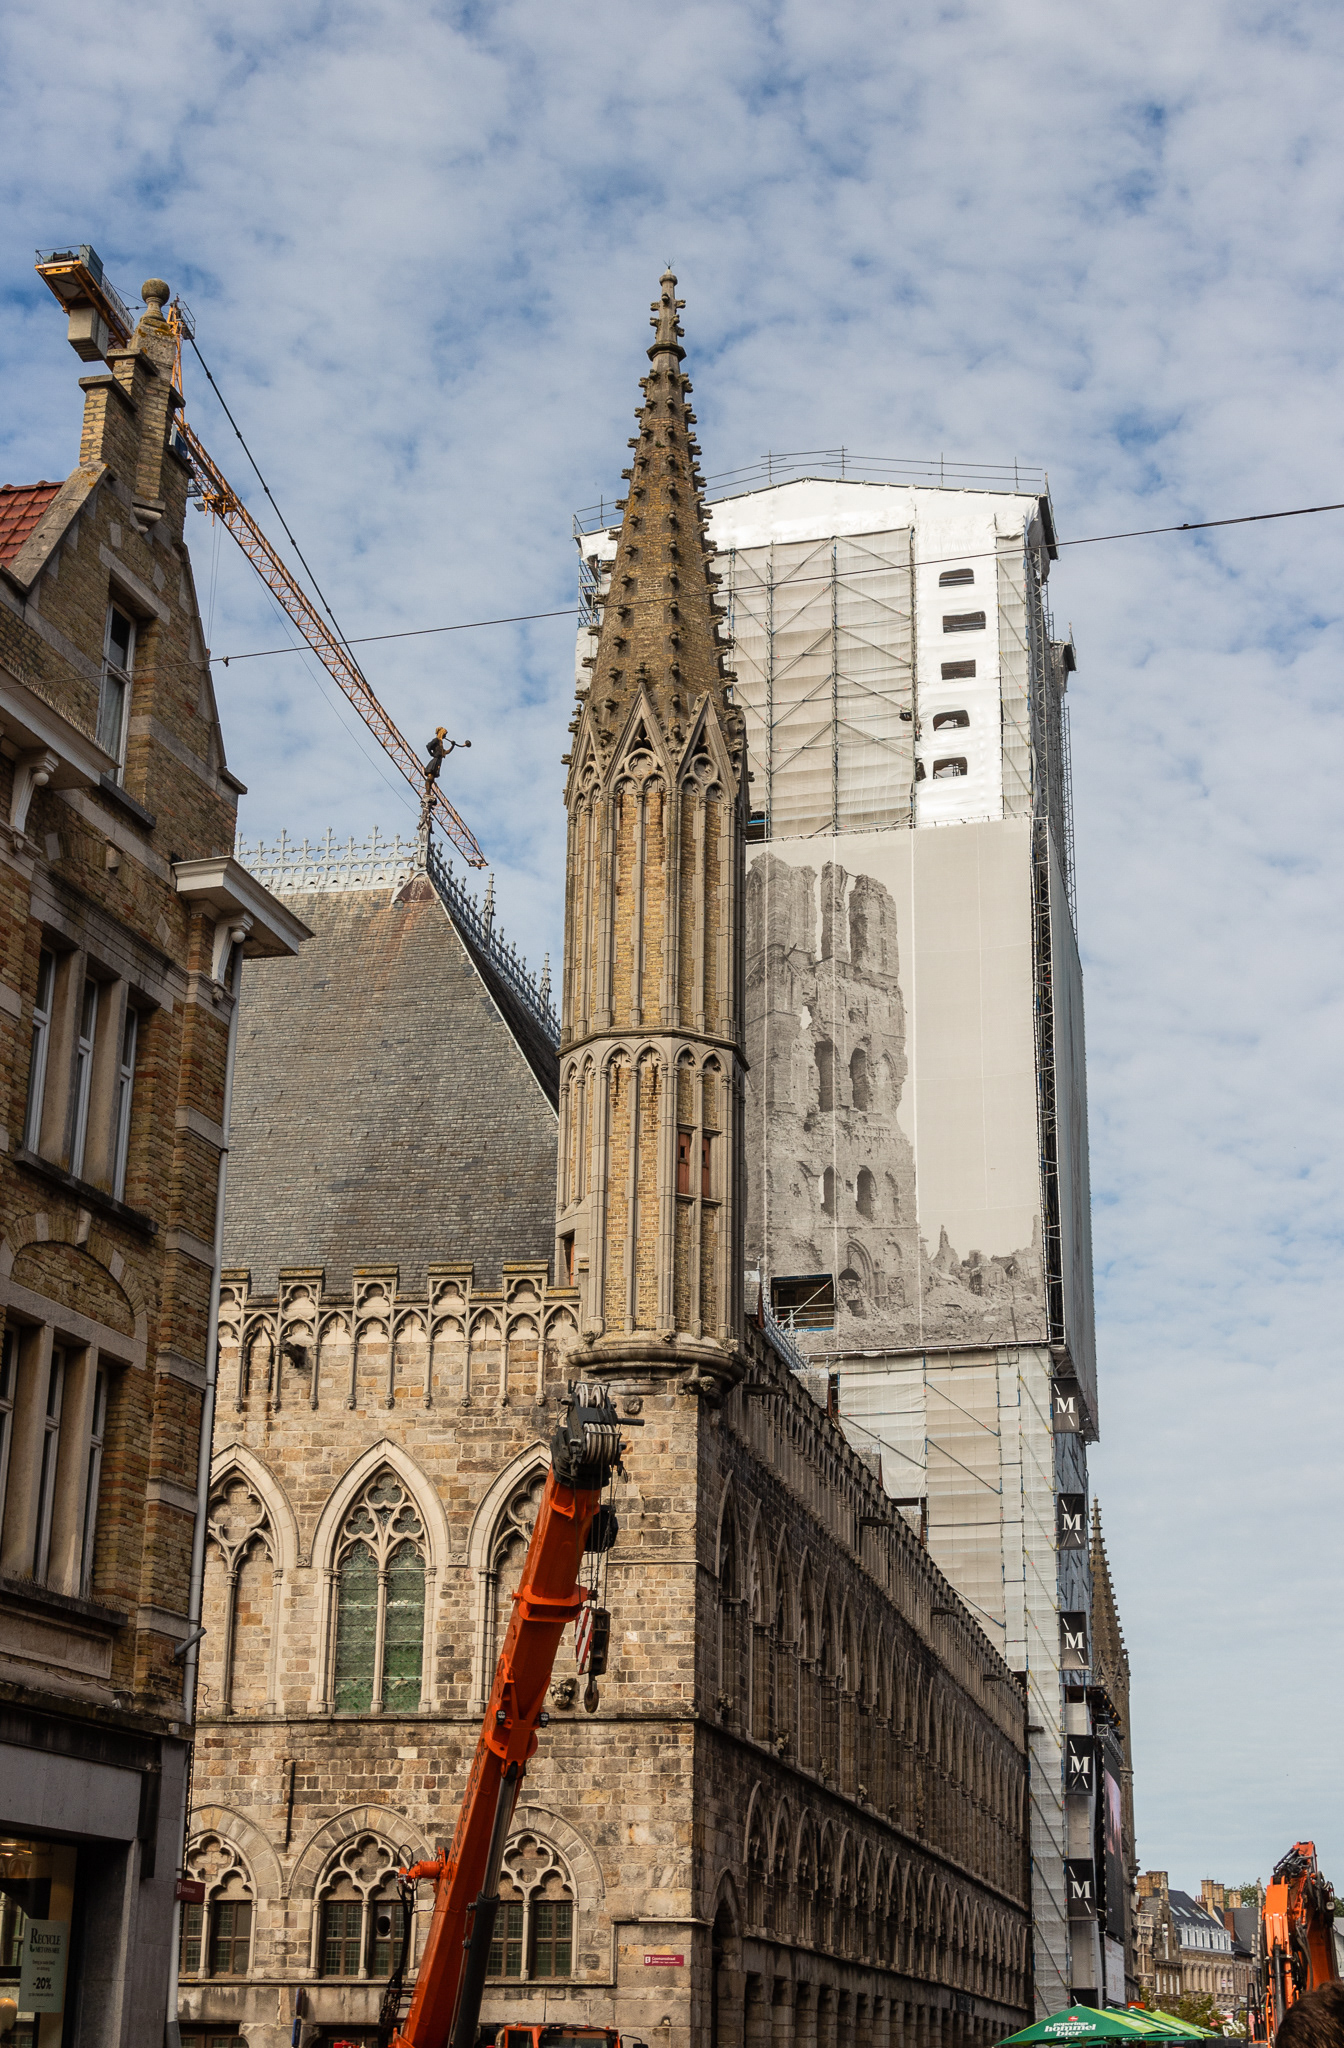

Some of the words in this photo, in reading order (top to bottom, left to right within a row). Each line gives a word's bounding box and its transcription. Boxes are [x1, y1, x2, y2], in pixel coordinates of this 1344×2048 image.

[1055, 1397, 1076, 1413] M
[1062, 1514, 1082, 1530] M
[1064, 1632, 1084, 1649] M
[1070, 1756, 1090, 1773] M
[1072, 1881, 1091, 1898] M
[31, 1928, 61, 1945] RECYCLE
[32, 1977, 52, 1990] -20%
[1044, 2024, 1097, 2033] hommel
